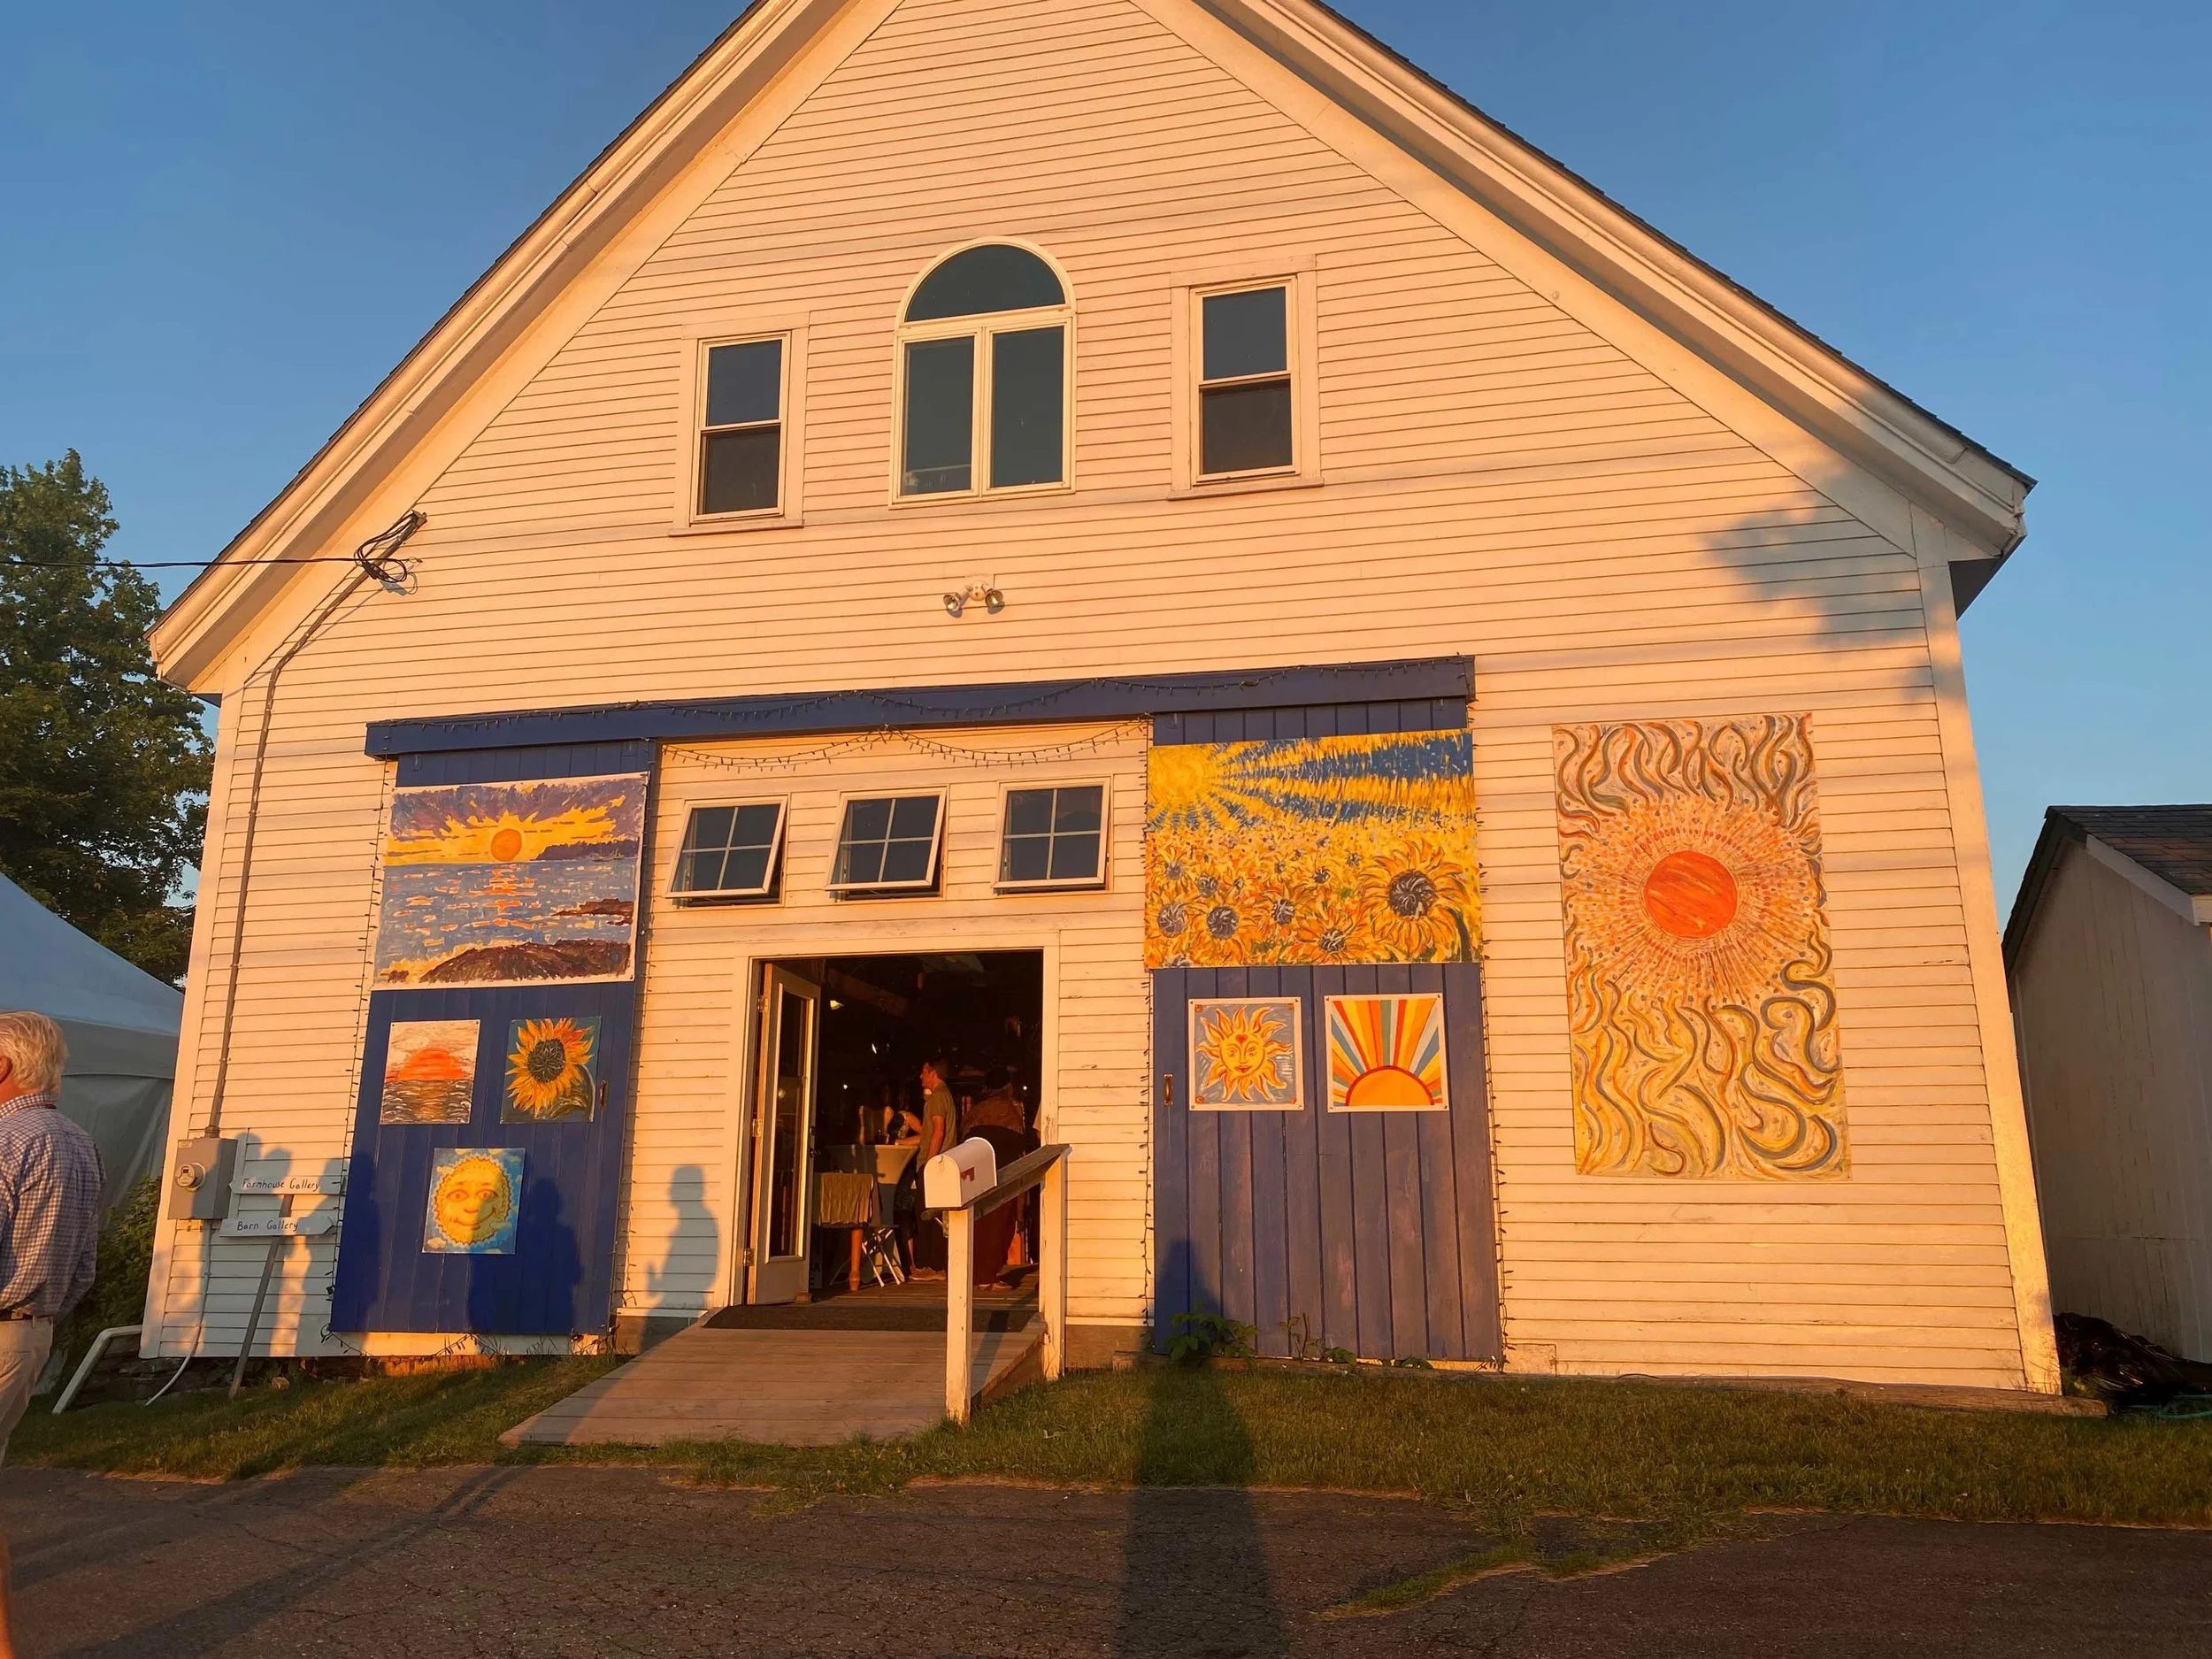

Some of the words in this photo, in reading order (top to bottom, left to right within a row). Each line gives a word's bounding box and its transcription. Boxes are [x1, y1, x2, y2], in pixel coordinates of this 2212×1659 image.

[242, 1178, 284, 1189] Farmhouse
[289, 1178, 319, 1192] Gallery
[237, 1221, 258, 1231] Barn
[267, 1220, 297, 1231] Gallery
